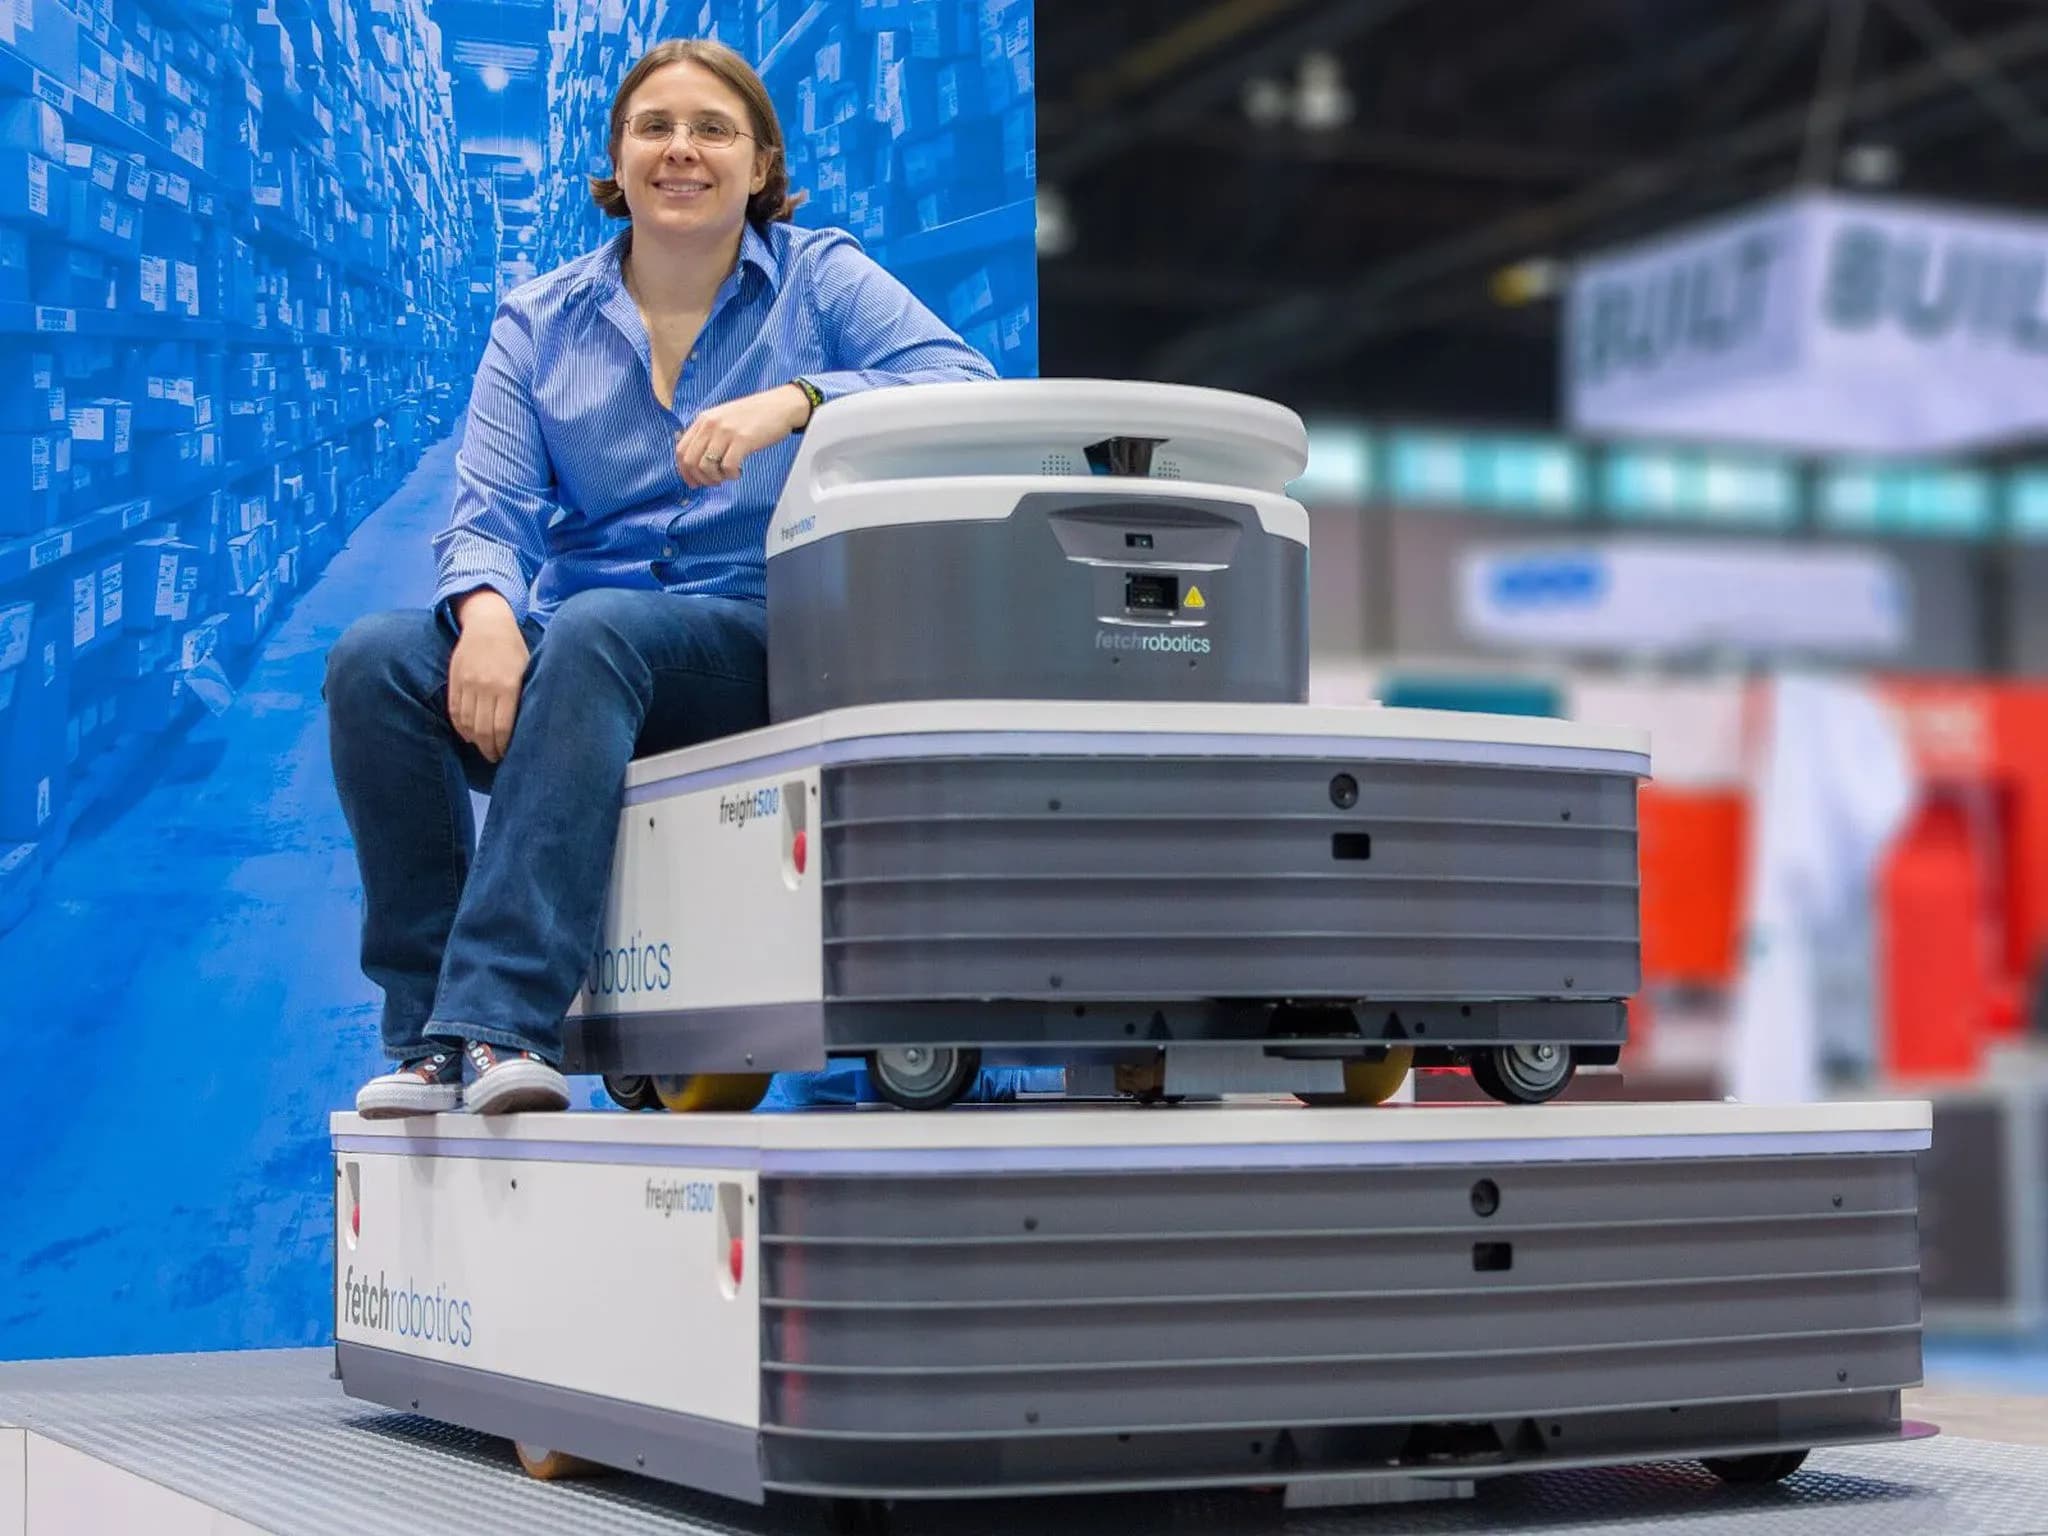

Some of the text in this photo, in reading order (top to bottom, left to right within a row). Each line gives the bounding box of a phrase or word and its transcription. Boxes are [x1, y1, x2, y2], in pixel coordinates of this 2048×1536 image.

[1095, 630, 1211, 654] fetchrobotics
[719, 786, 779, 828] freight500
[584, 930, 671, 995] obotics
[646, 1177, 715, 1219] freight1500
[344, 1264, 472, 1348] fetchrobotics
